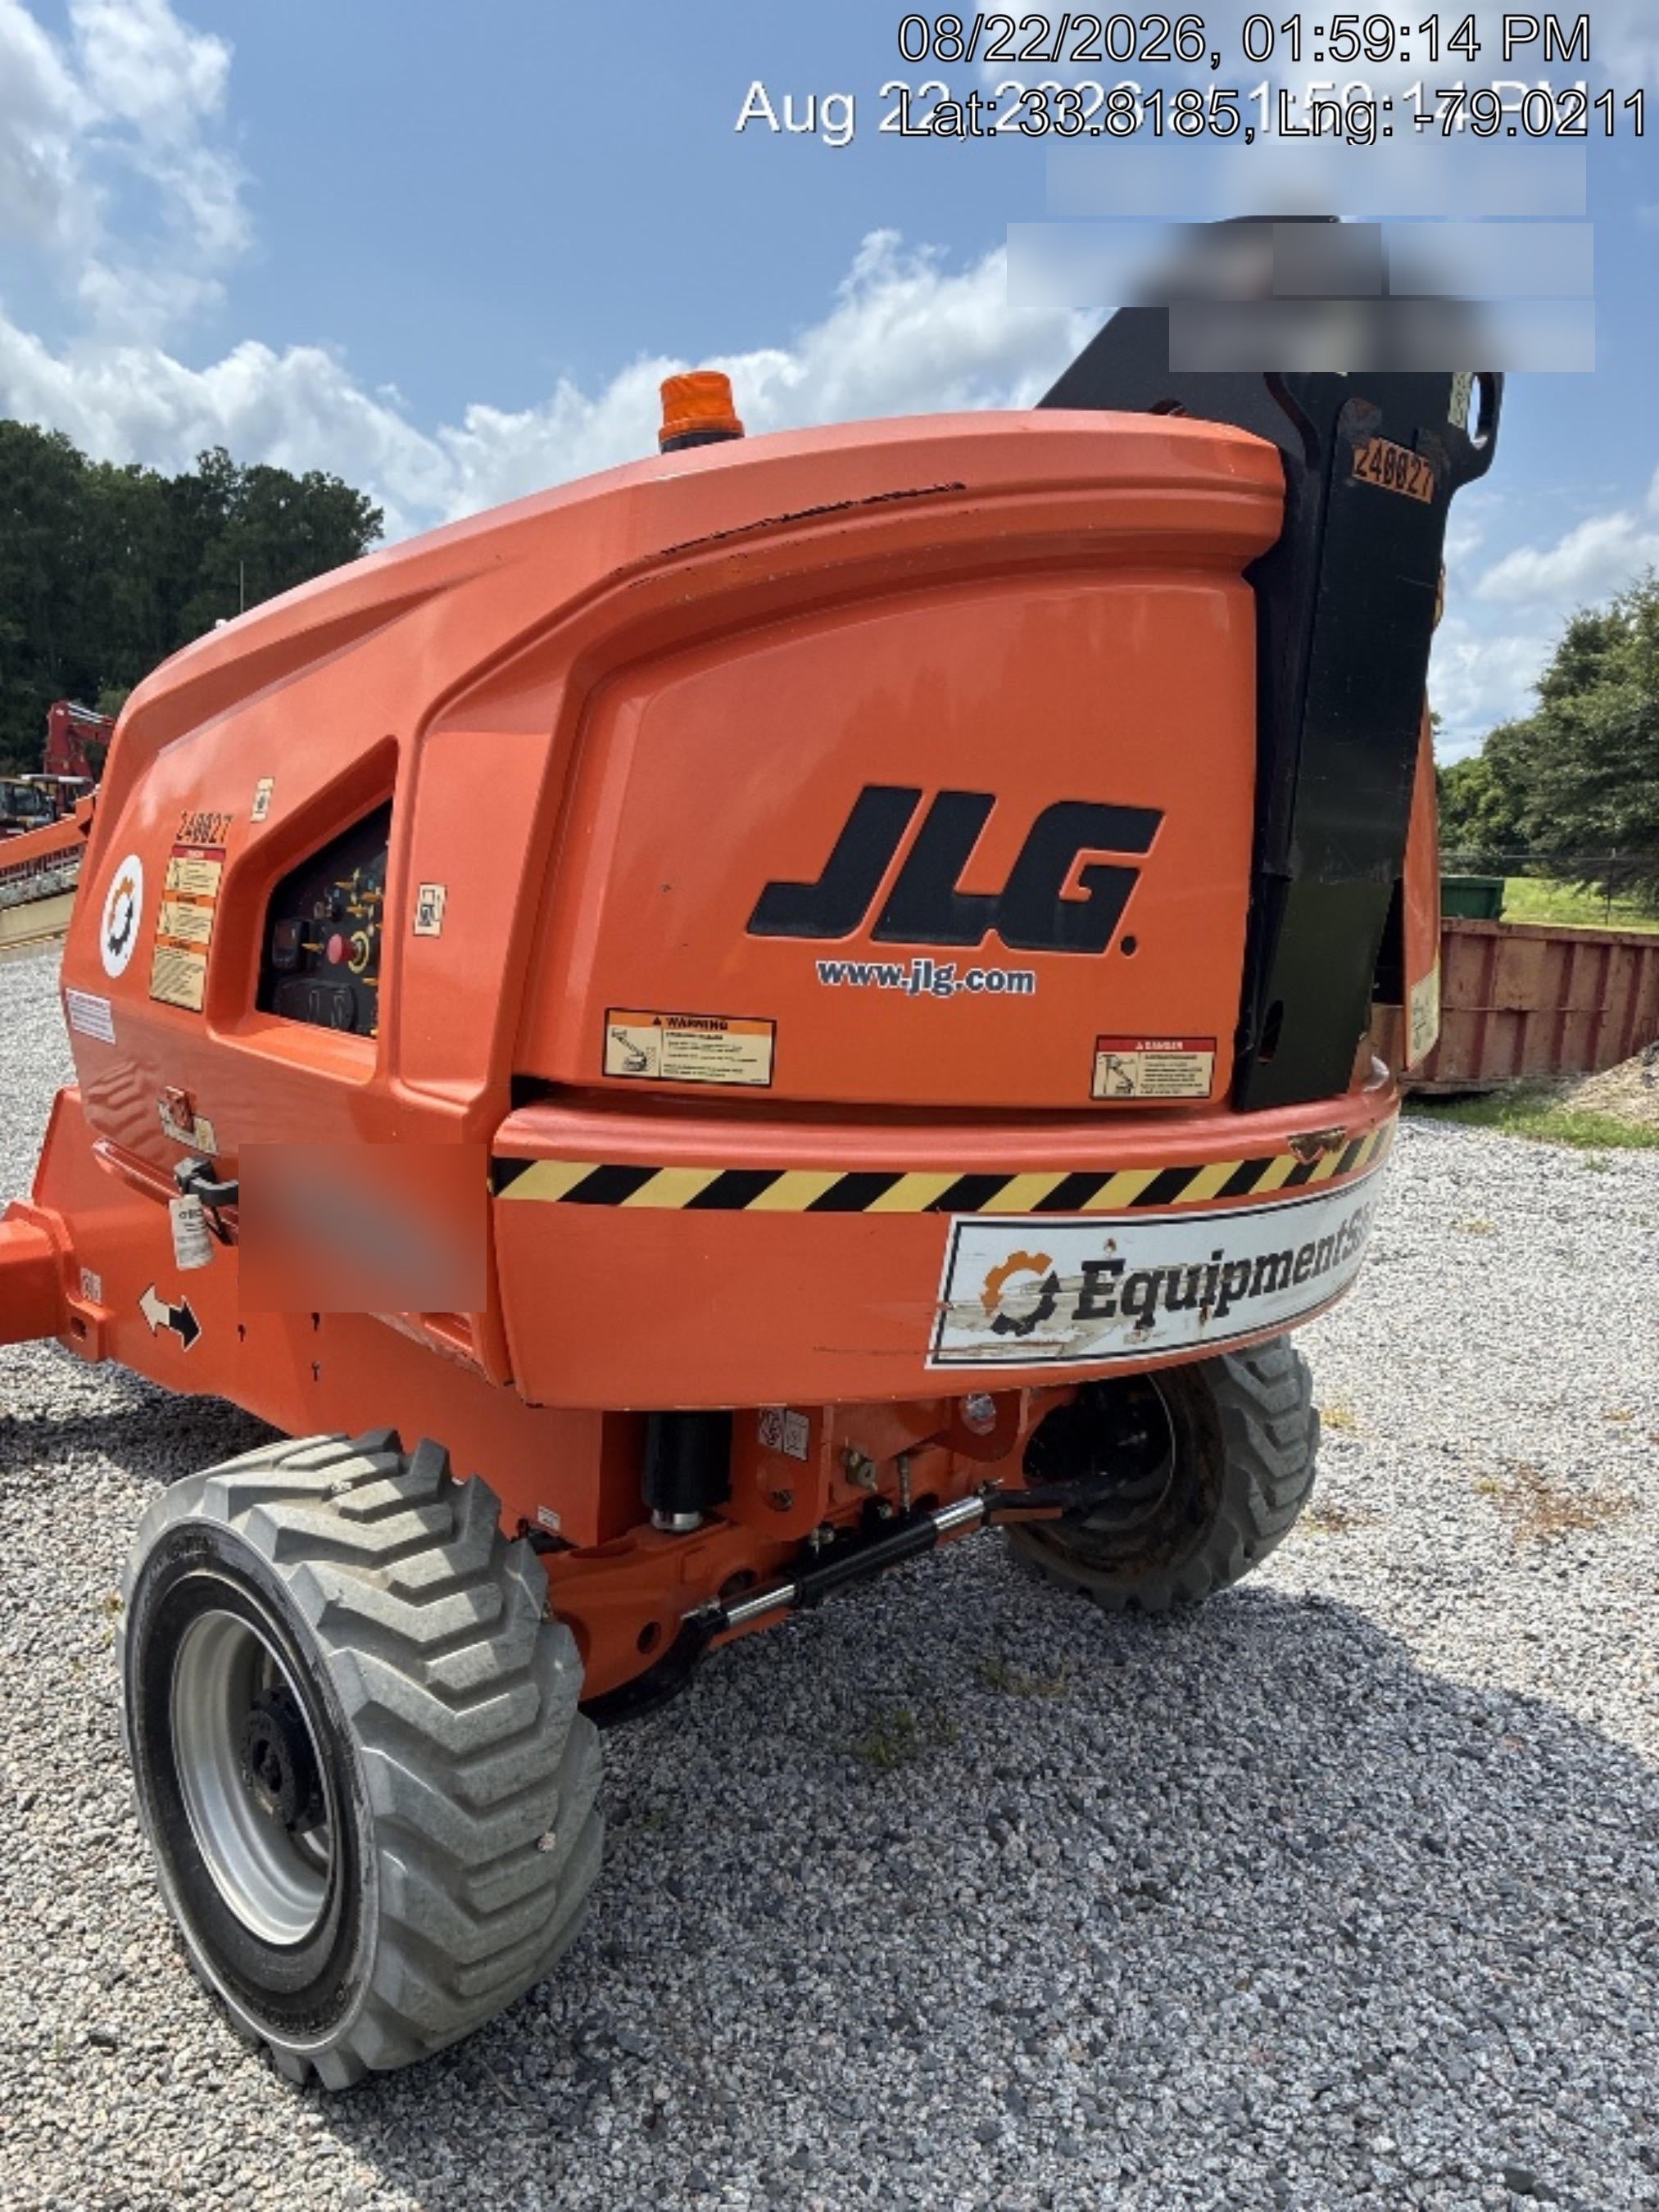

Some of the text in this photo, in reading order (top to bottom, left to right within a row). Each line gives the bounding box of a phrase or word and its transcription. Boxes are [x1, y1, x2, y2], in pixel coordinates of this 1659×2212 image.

[1355, 441, 1432, 498] 240027
[175, 809, 233, 844] 240027
[816, 958, 1036, 997] www.jlg.com
